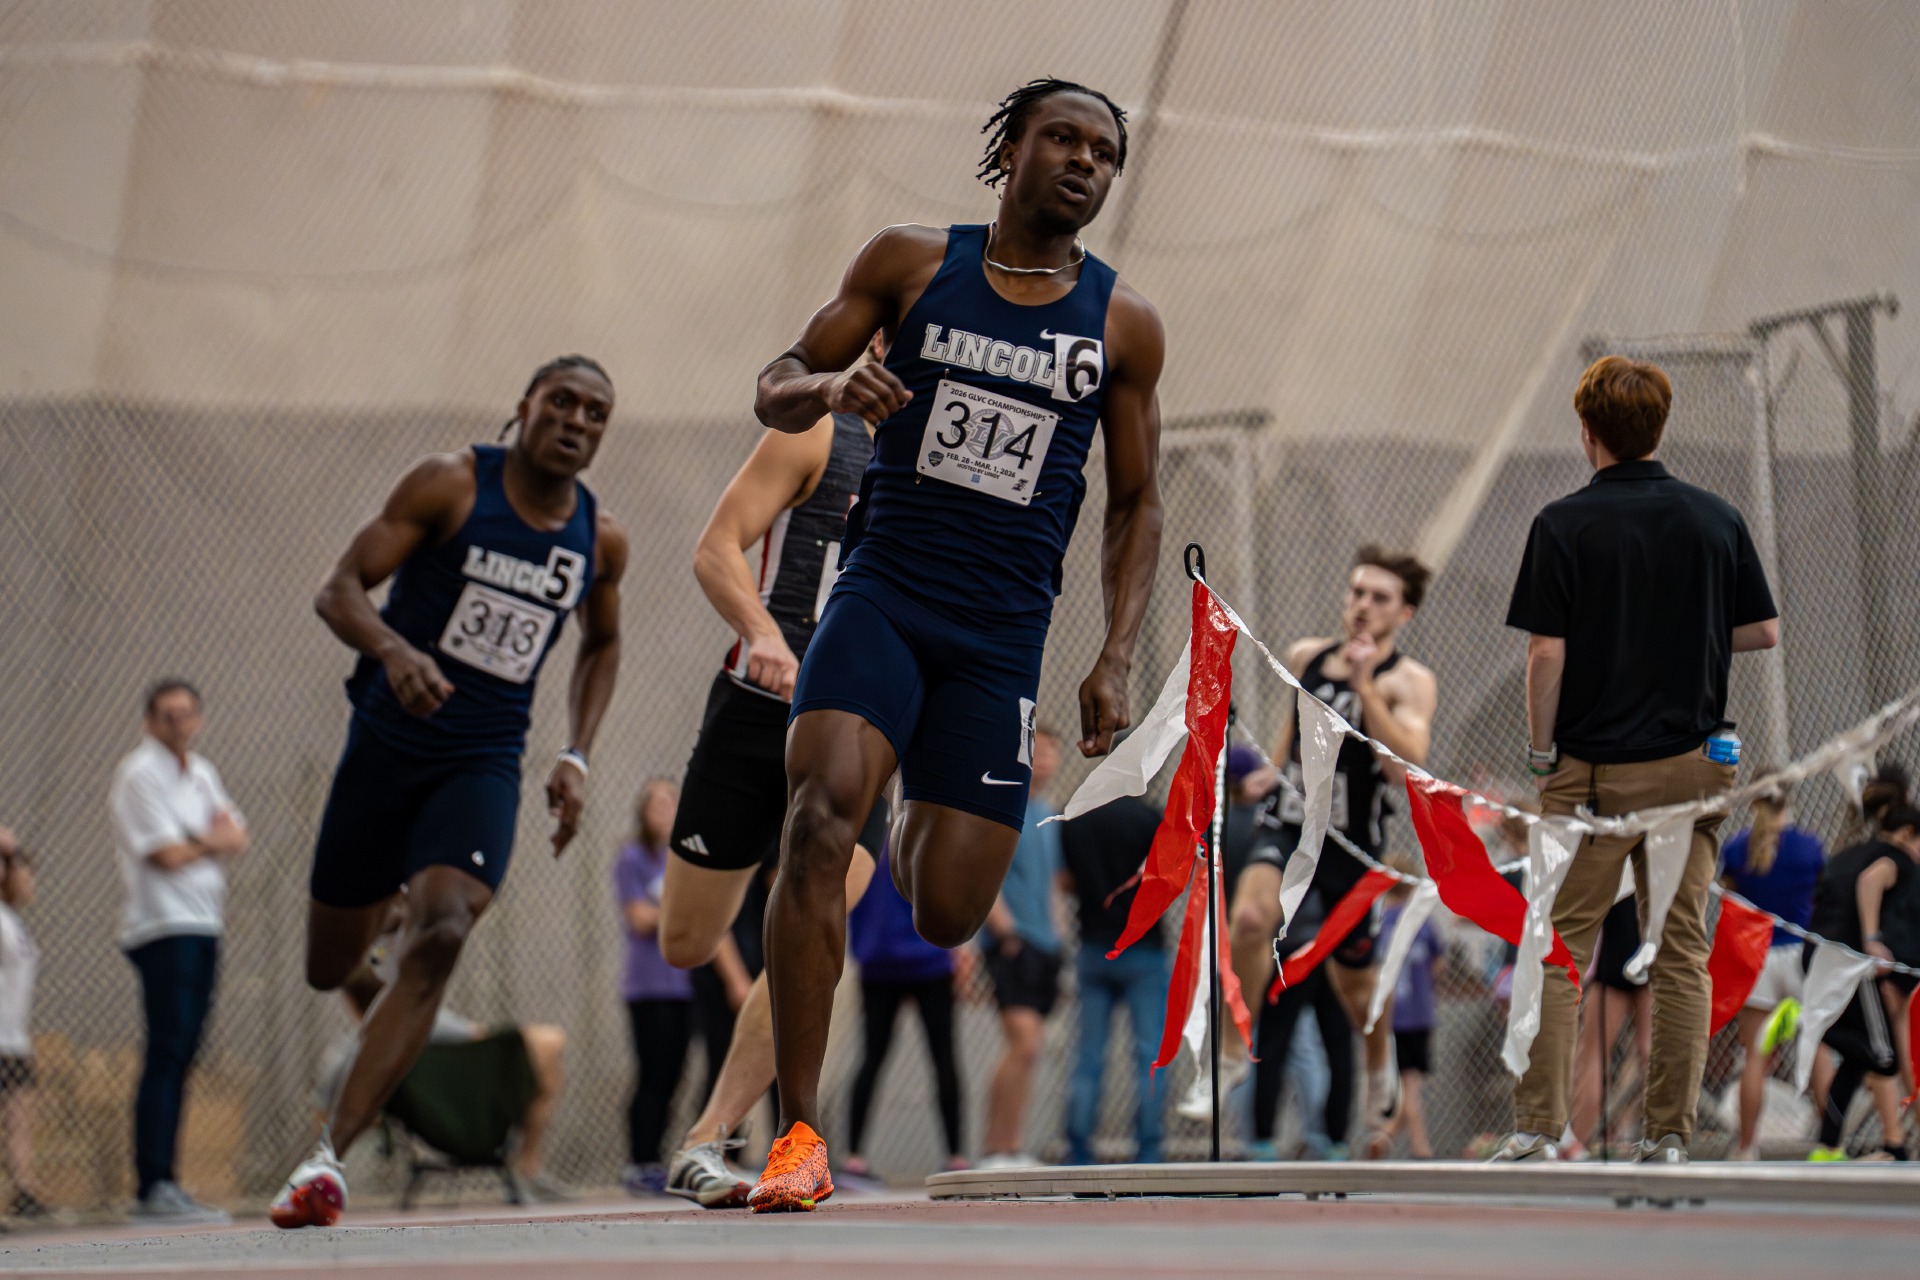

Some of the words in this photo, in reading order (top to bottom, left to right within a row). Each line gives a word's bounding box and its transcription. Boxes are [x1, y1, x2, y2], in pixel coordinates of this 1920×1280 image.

[920, 323, 1055, 389] LINCOL
[1066, 339, 1098, 400] 6
[950, 388, 967, 398] 2026
[968, 393, 987, 403] GLVC
[987, 398, 1047, 422] CHAMPIONSHIPS
[936, 400, 1038, 470] 314
[946, 452, 960, 461] FEB.
[961, 456, 970, 464] 28
[974, 460, 991, 470] MAR.
[1000, 469, 1016, 478] 2026
[956, 463, 976, 472] HOSTED
[545, 557, 572, 600] 5
[461, 601, 540, 656] 313
